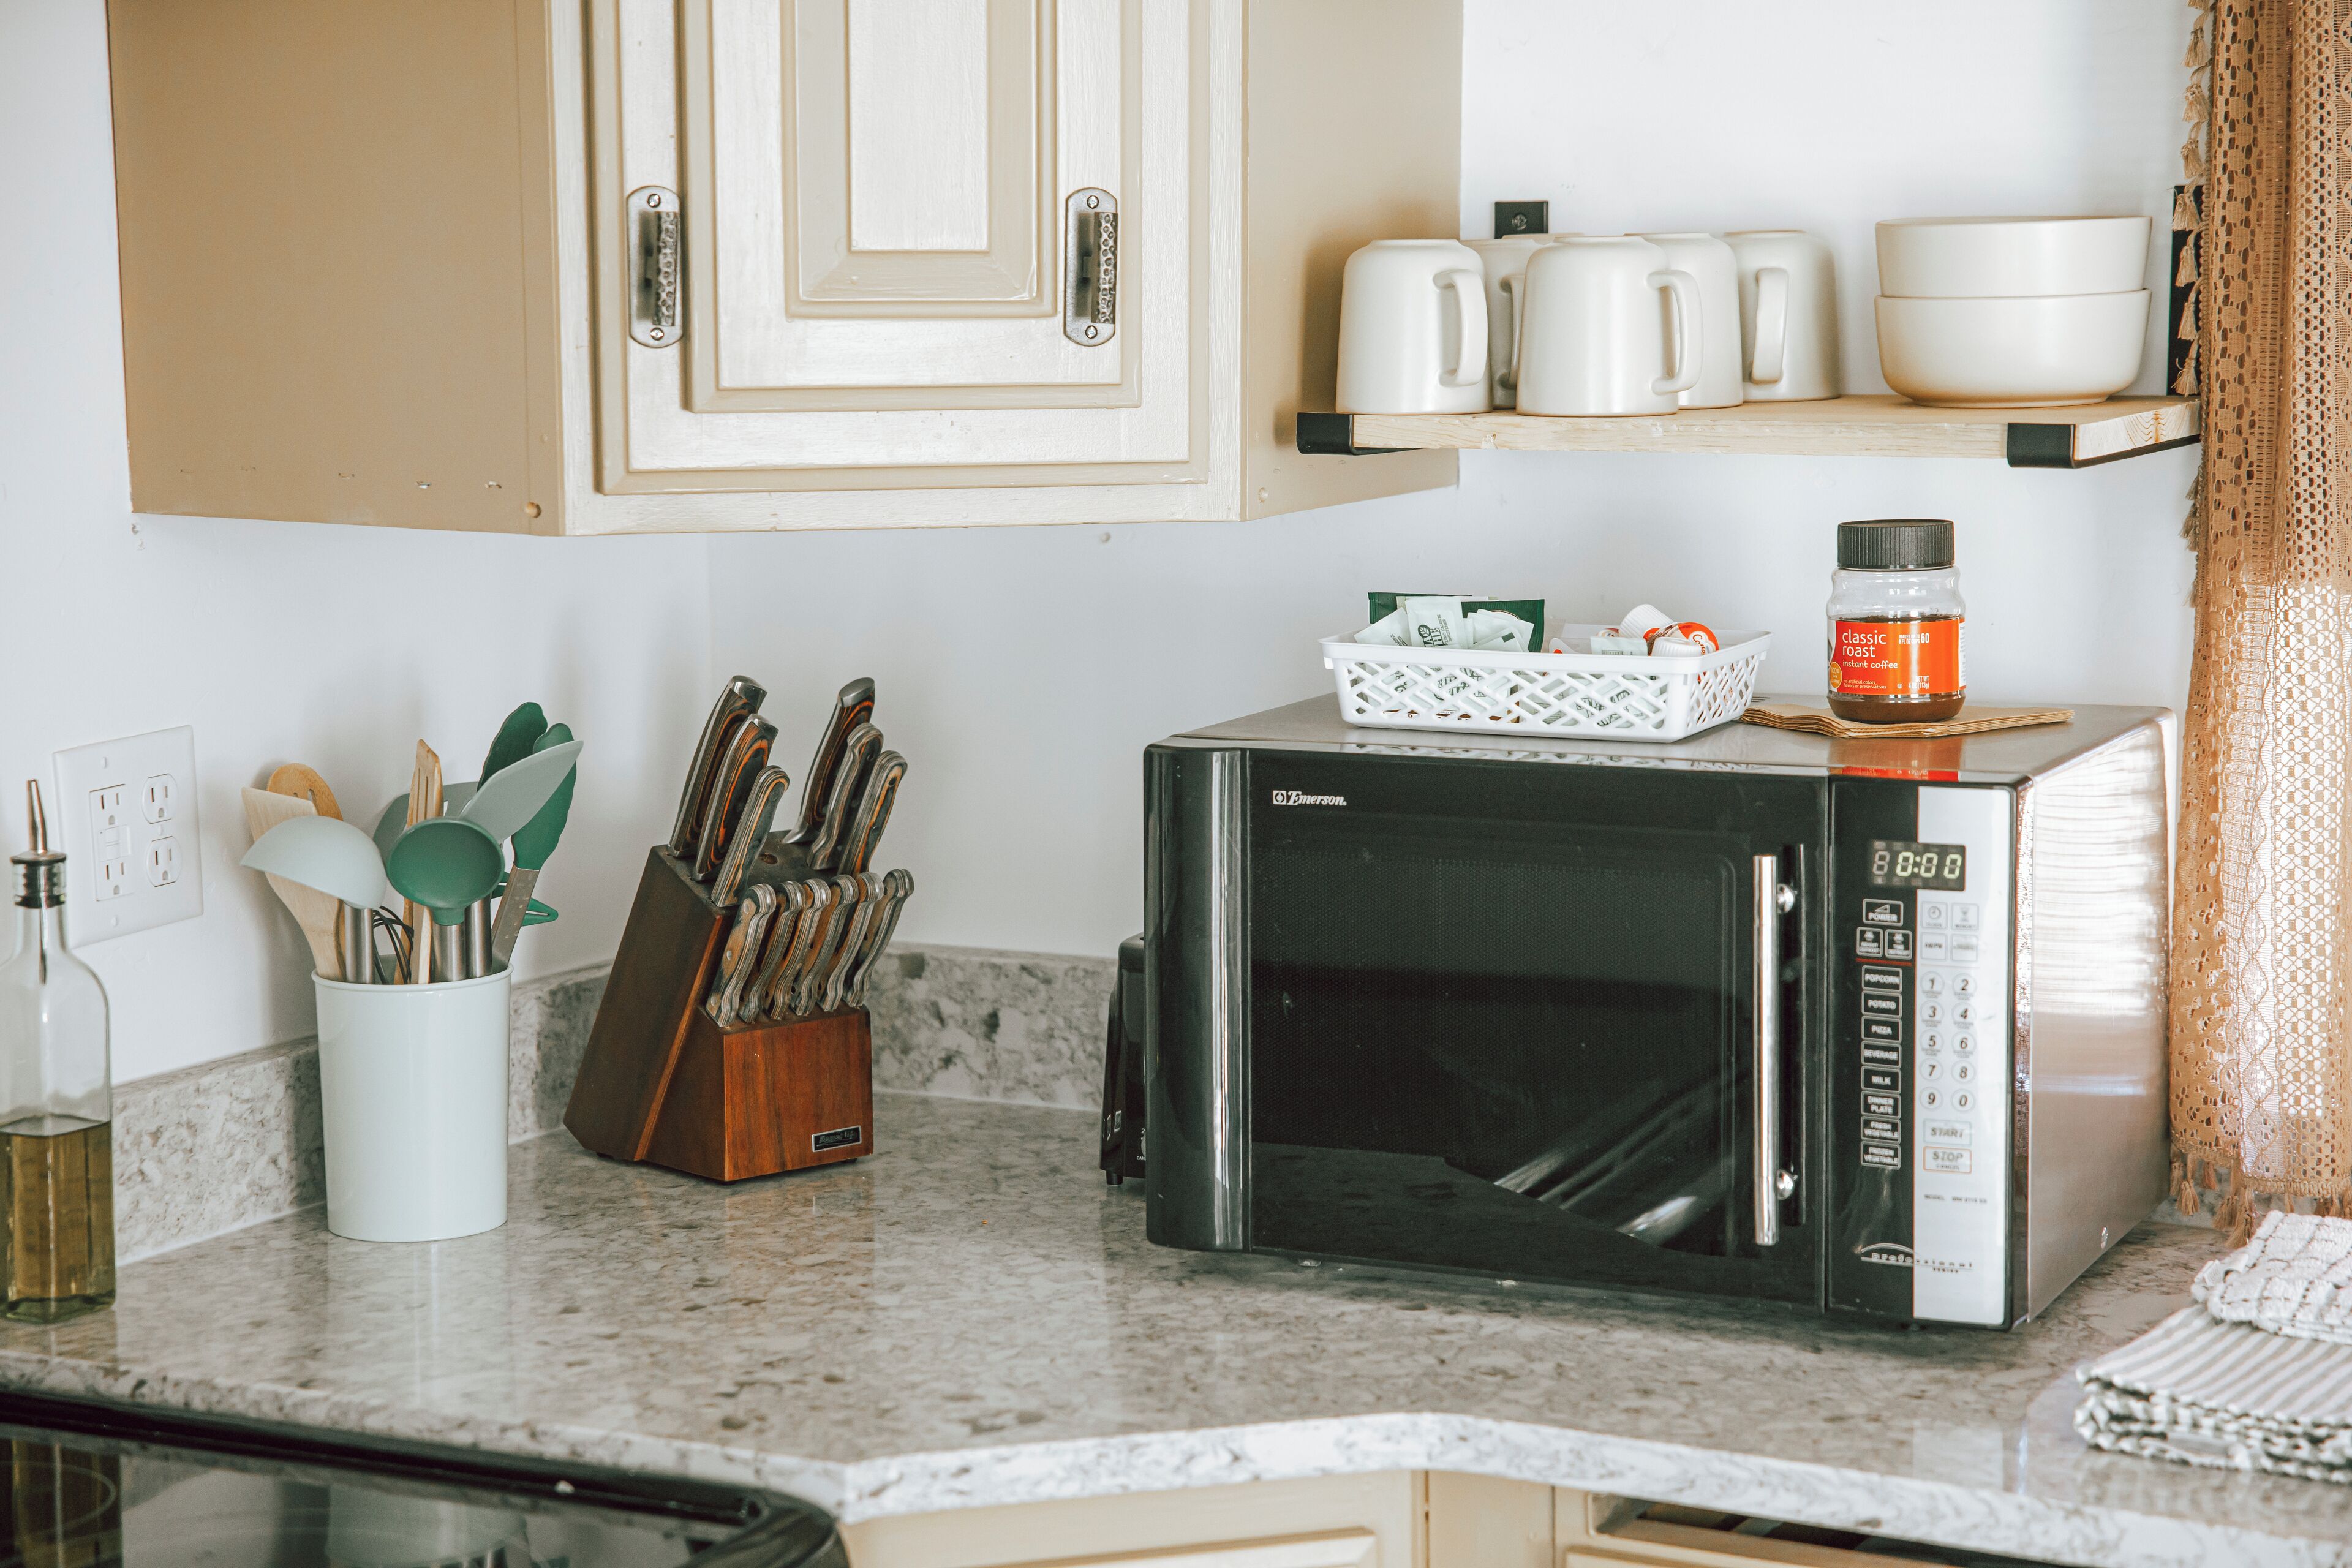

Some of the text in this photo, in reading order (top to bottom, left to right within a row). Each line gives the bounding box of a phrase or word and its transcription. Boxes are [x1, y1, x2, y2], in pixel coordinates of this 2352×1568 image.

[1842, 629, 1887, 644] classic
[1921, 633, 1929, 644] 60
[1842, 645, 1875, 657] roast
[1842, 660, 1898, 669] instant coffee
[1868, 912, 1898, 922] POWER
[1865, 973, 1899, 984] POPCORN
[1929, 976, 1936, 989] 1
[1961, 978, 1969, 991] 2
[1868, 1000, 1896, 1010] POTATO
[1928, 1006, 1937, 1018] 3
[1960, 1008, 1969, 1019] 4
[1872, 1025, 1892, 1035] PIZZA
[1929, 1035, 1936, 1047] 5
[1960, 1037, 1968, 1049] 6
[1864, 1049, 1898, 1061] BEVERAGE
[1929, 1064, 1937, 1077] 7
[1960, 1066, 1968, 1079] 8
[1872, 1076, 1891, 1085] MILK
[1928, 1092, 1936, 1104] 9
[1959, 1095, 1967, 1107] 0
[1871, 1104, 1893, 1115] PLATE
[1931, 1127, 1964, 1138] START
[1932, 1151, 1964, 1162] STOP
